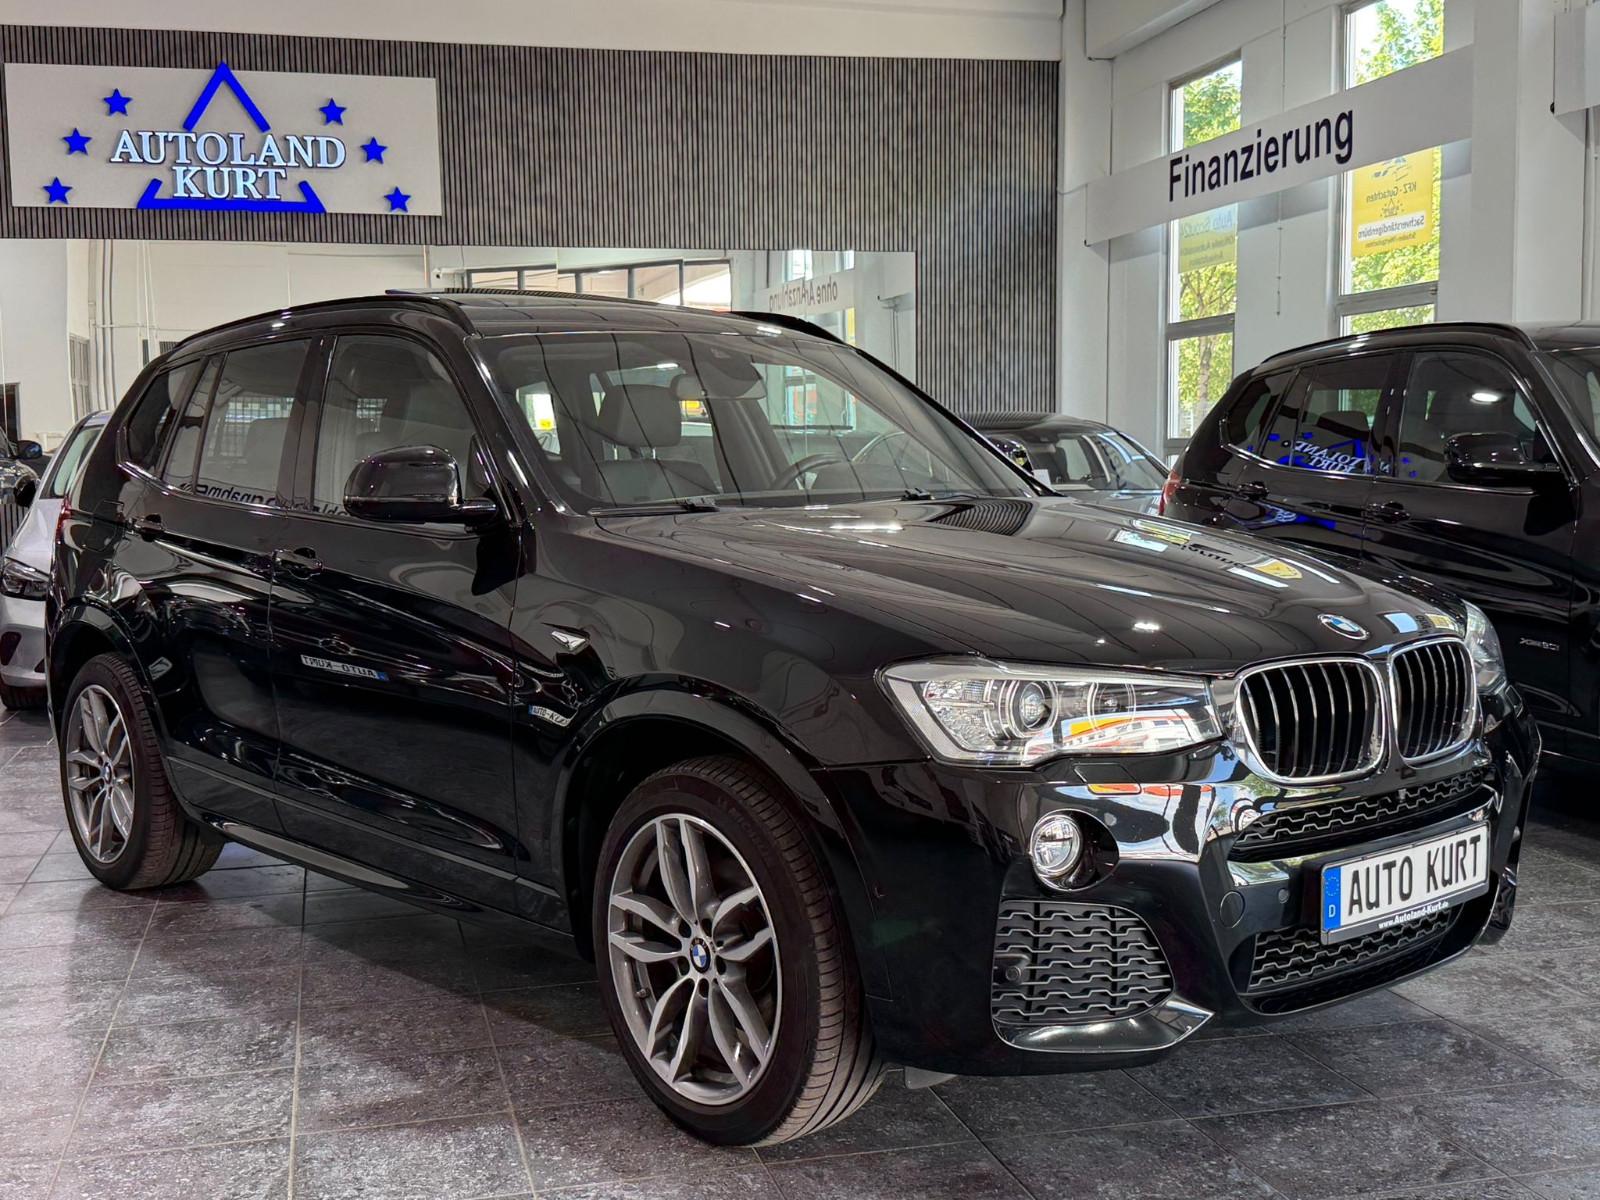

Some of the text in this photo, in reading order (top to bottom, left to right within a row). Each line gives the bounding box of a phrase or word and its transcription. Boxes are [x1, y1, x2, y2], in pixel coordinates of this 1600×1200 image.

[109, 130, 346, 168] AUTOLAND
[1168, 110, 1354, 202] Finanzierung
[172, 166, 287, 200] KURT
[1348, 834, 1482, 917] AUTO KURT
[1328, 904, 1336, 918] D
